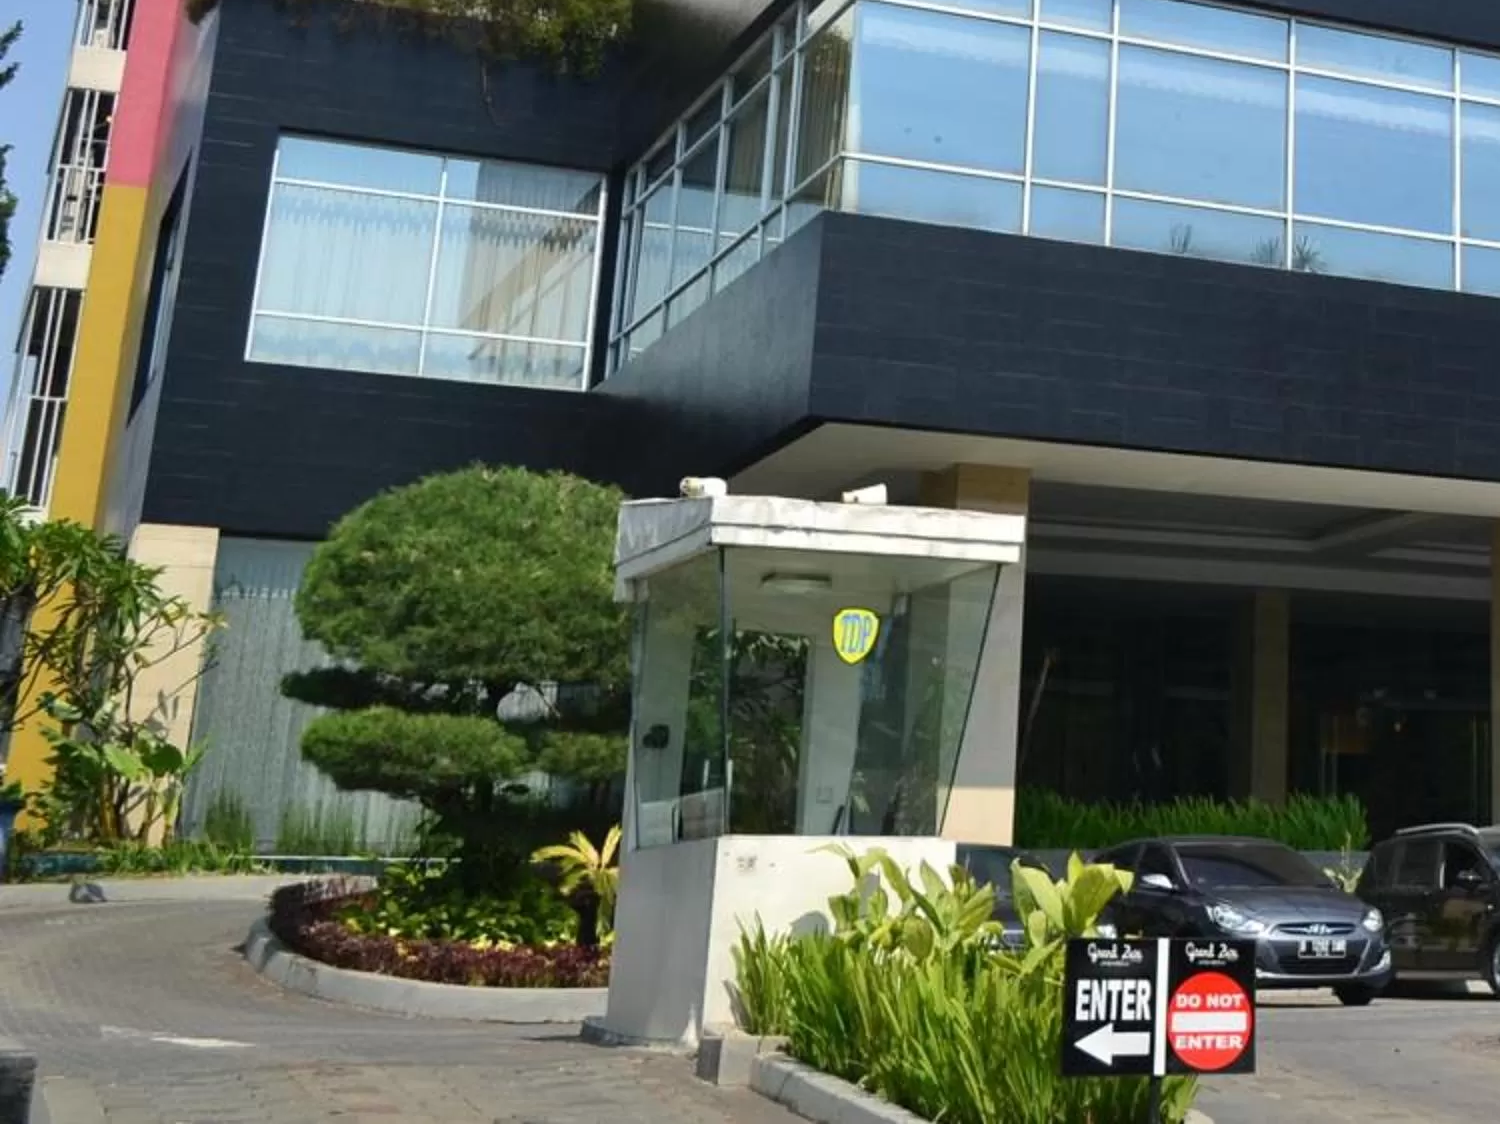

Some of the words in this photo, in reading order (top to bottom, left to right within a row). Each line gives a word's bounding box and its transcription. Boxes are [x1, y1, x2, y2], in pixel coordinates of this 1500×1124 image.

[1075, 979, 1152, 1021] ENTER
[1176, 994, 1202, 1008] DO
[1206, 993, 1245, 1007] NOT
[1175, 1035, 1243, 1050] ENTER
